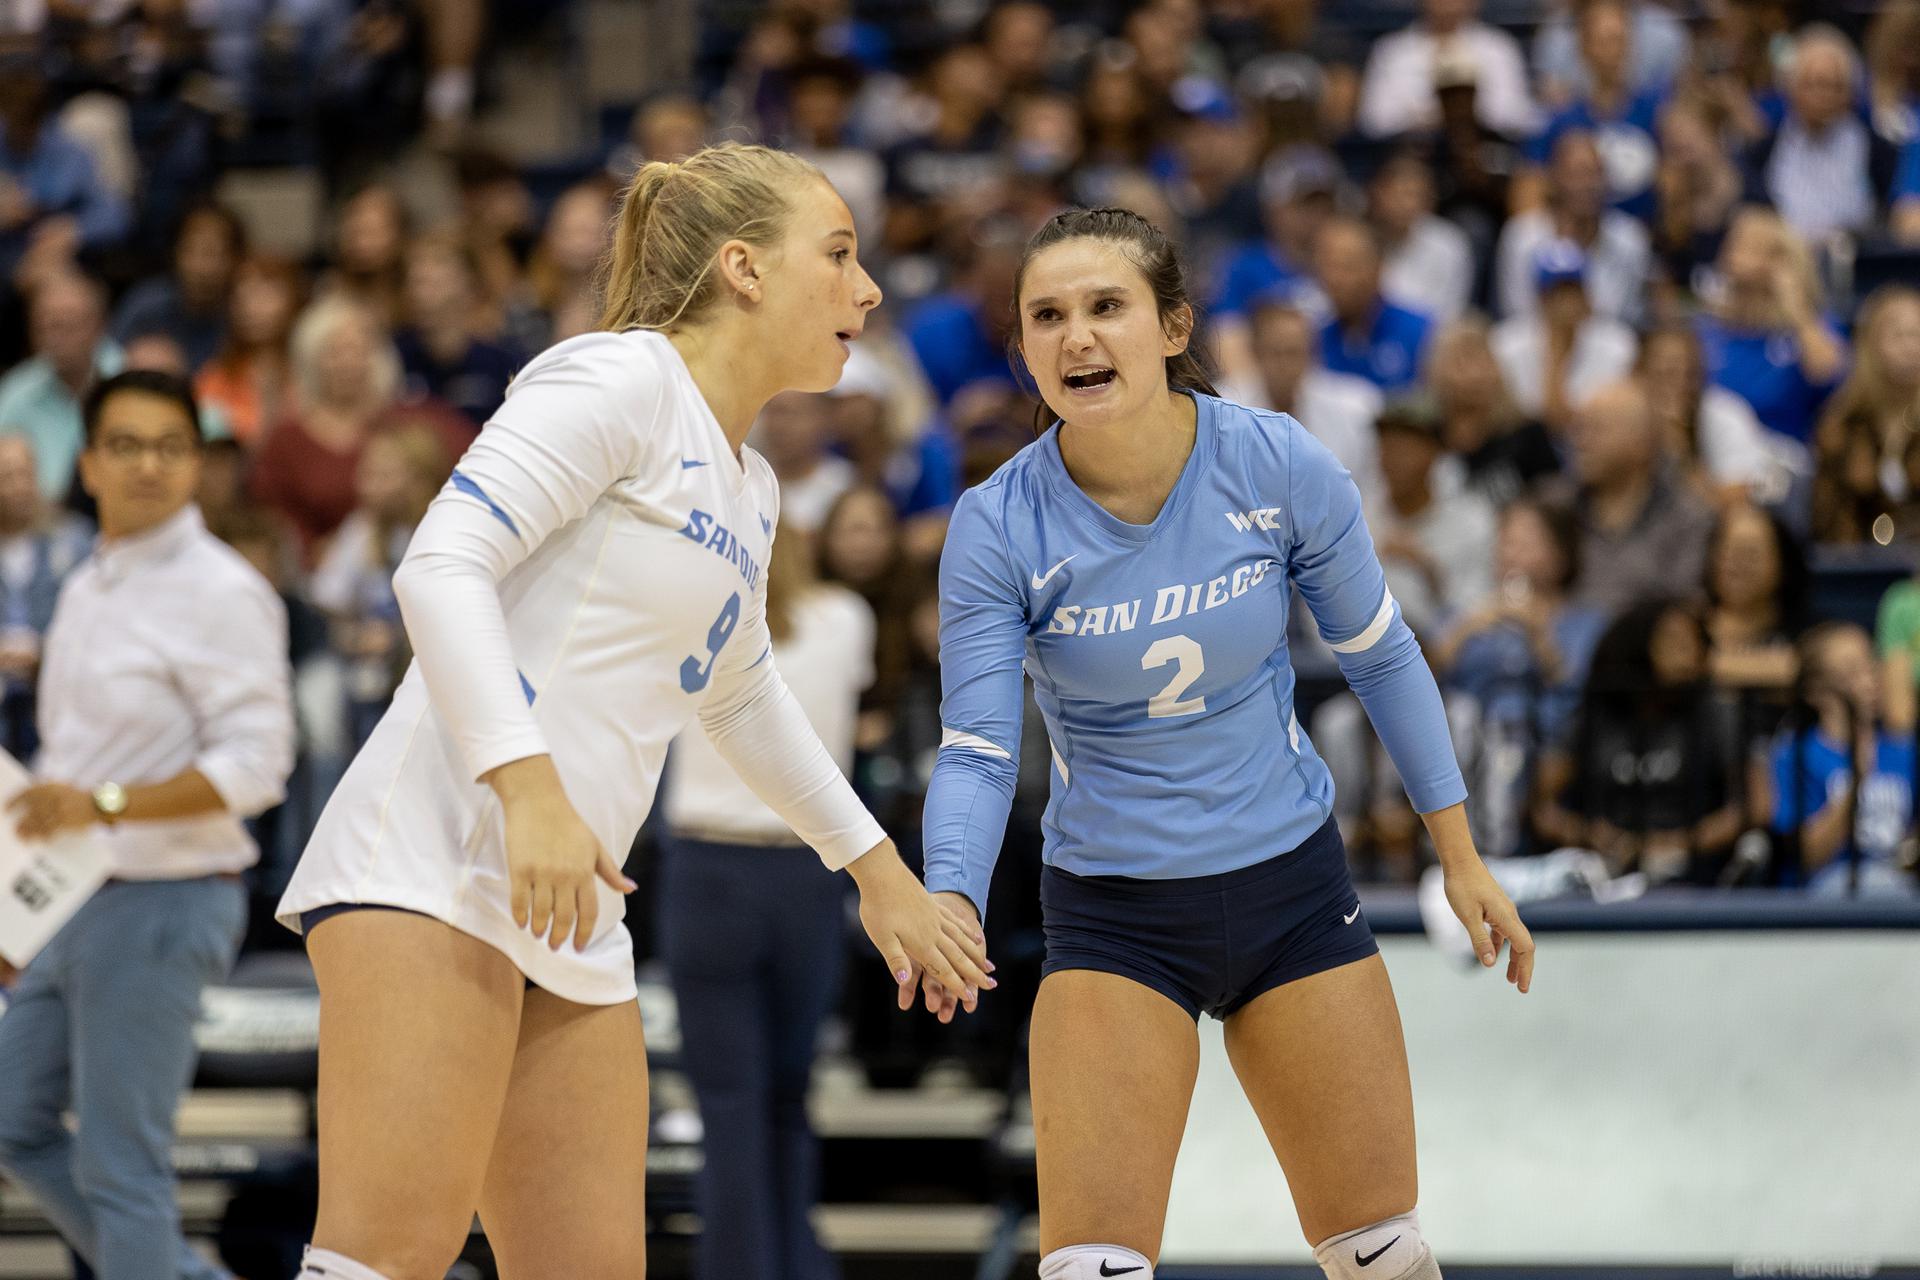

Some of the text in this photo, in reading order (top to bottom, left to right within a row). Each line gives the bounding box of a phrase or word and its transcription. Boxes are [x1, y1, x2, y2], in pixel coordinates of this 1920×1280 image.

[676, 508, 741, 566] SAN
[1047, 558, 1273, 636] SAN DIEGO
[680, 591, 741, 694] 9
[1141, 634, 1207, 718] 2
